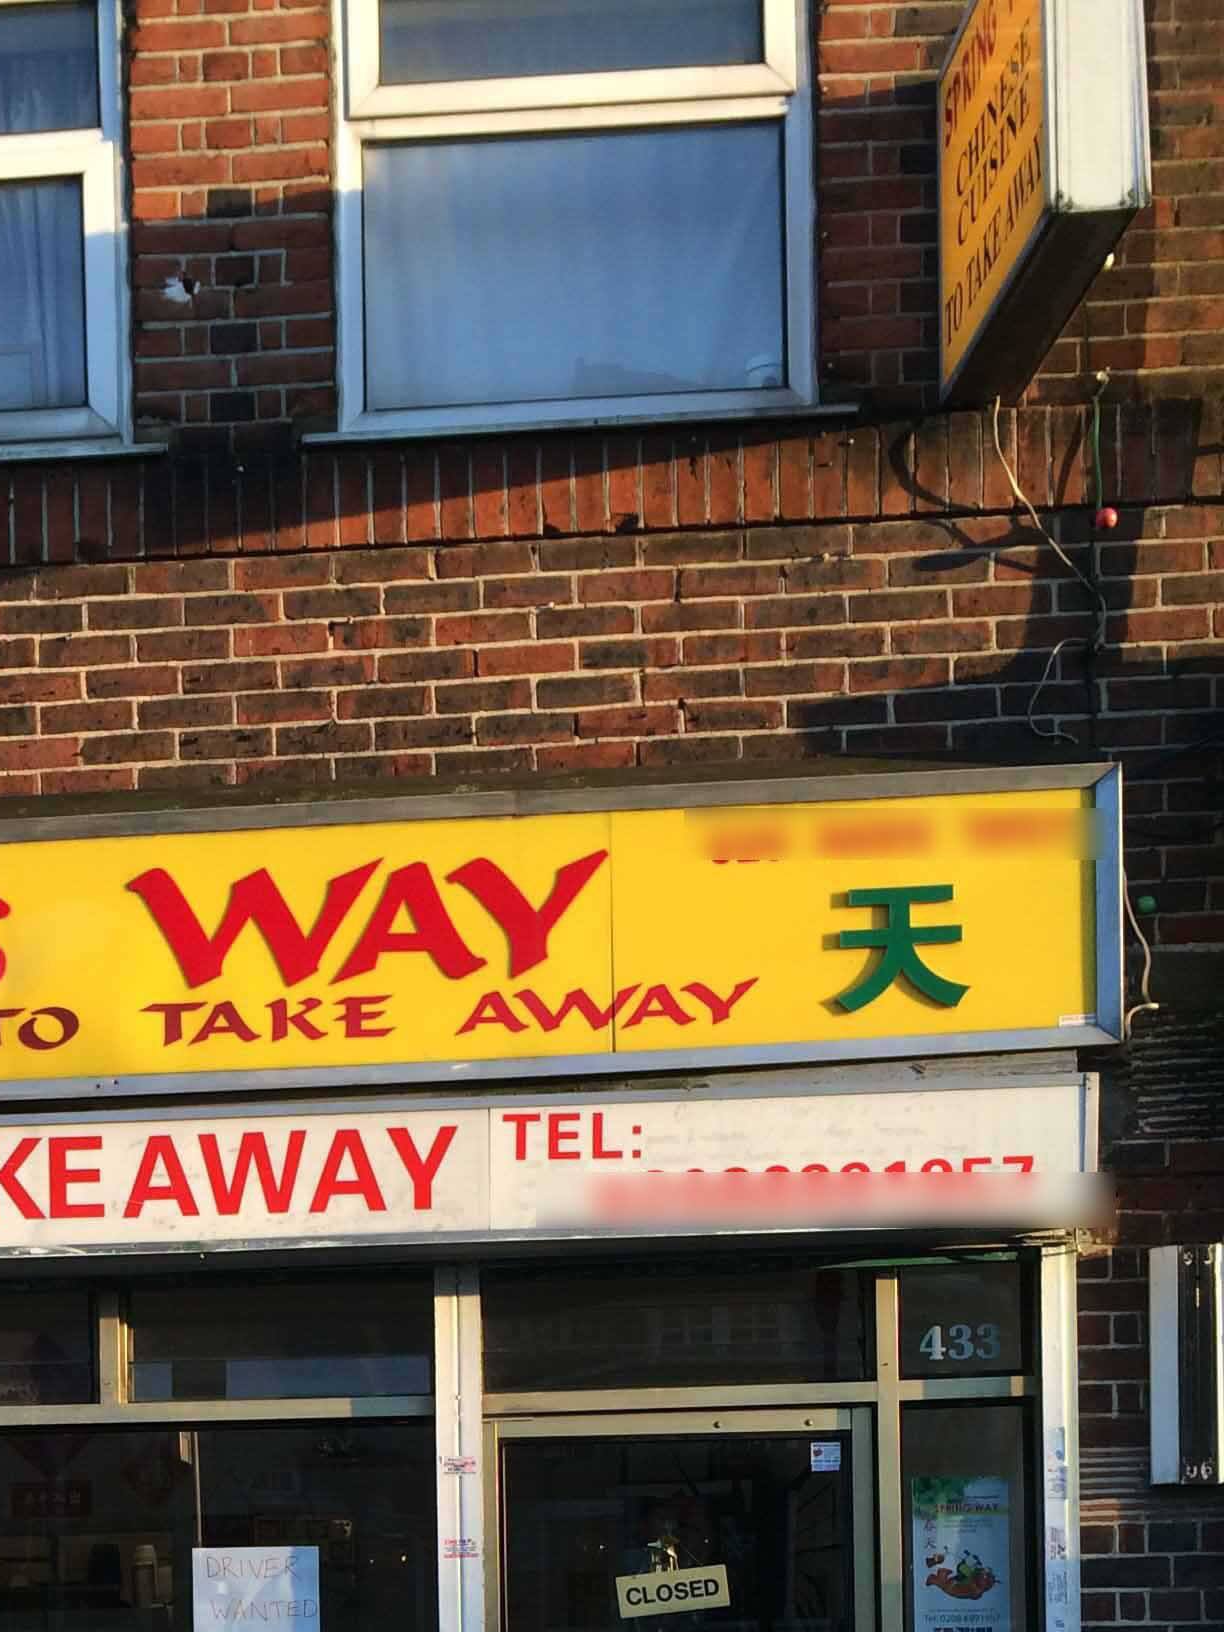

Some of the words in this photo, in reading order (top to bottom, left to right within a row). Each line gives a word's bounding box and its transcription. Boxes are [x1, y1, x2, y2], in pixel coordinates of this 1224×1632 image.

[956, 17, 1031, 197] CHINESE
[957, 72, 1031, 246] CUISINE
[945, 281, 964, 346] TO
[966, 207, 1001, 310] TAKE
[1004, 125, 1043, 241] AWAY
[126, 850, 609, 989] WAY
[835, 884, 970, 1013] 天
[141, 994, 395, 1046] TAKE
[454, 975, 760, 1037] AWAY
[502, 1111, 644, 1162] TEL:
[919, 1324, 1000, 1361] 433
[206, 1556, 302, 1581] DRIVER
[625, 1578, 720, 1606] CLOSED
[209, 1599, 318, 1621] WANTED
